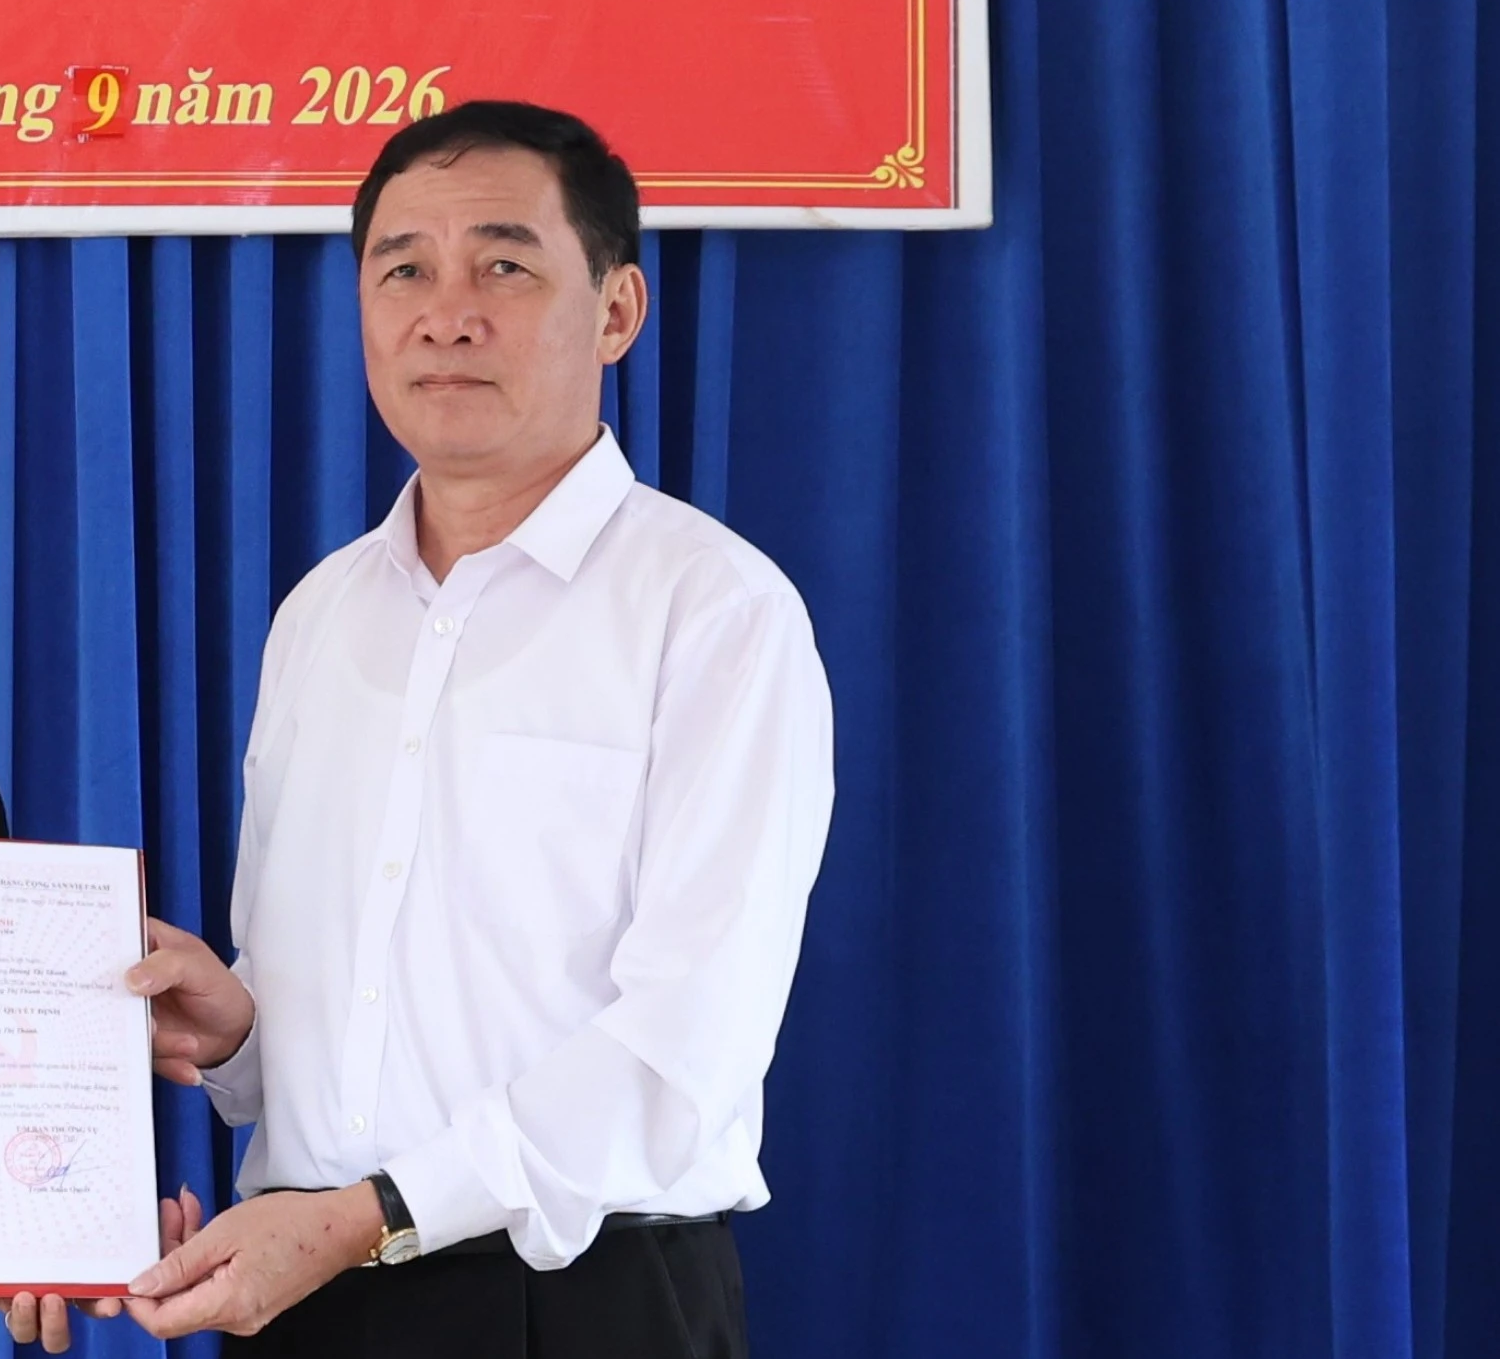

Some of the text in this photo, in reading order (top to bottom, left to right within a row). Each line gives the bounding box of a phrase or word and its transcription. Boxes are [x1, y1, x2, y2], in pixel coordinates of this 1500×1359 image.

[85, 72, 121, 131] 9
[130, 65, 274, 126] năm
[290, 65, 453, 125] 2026
